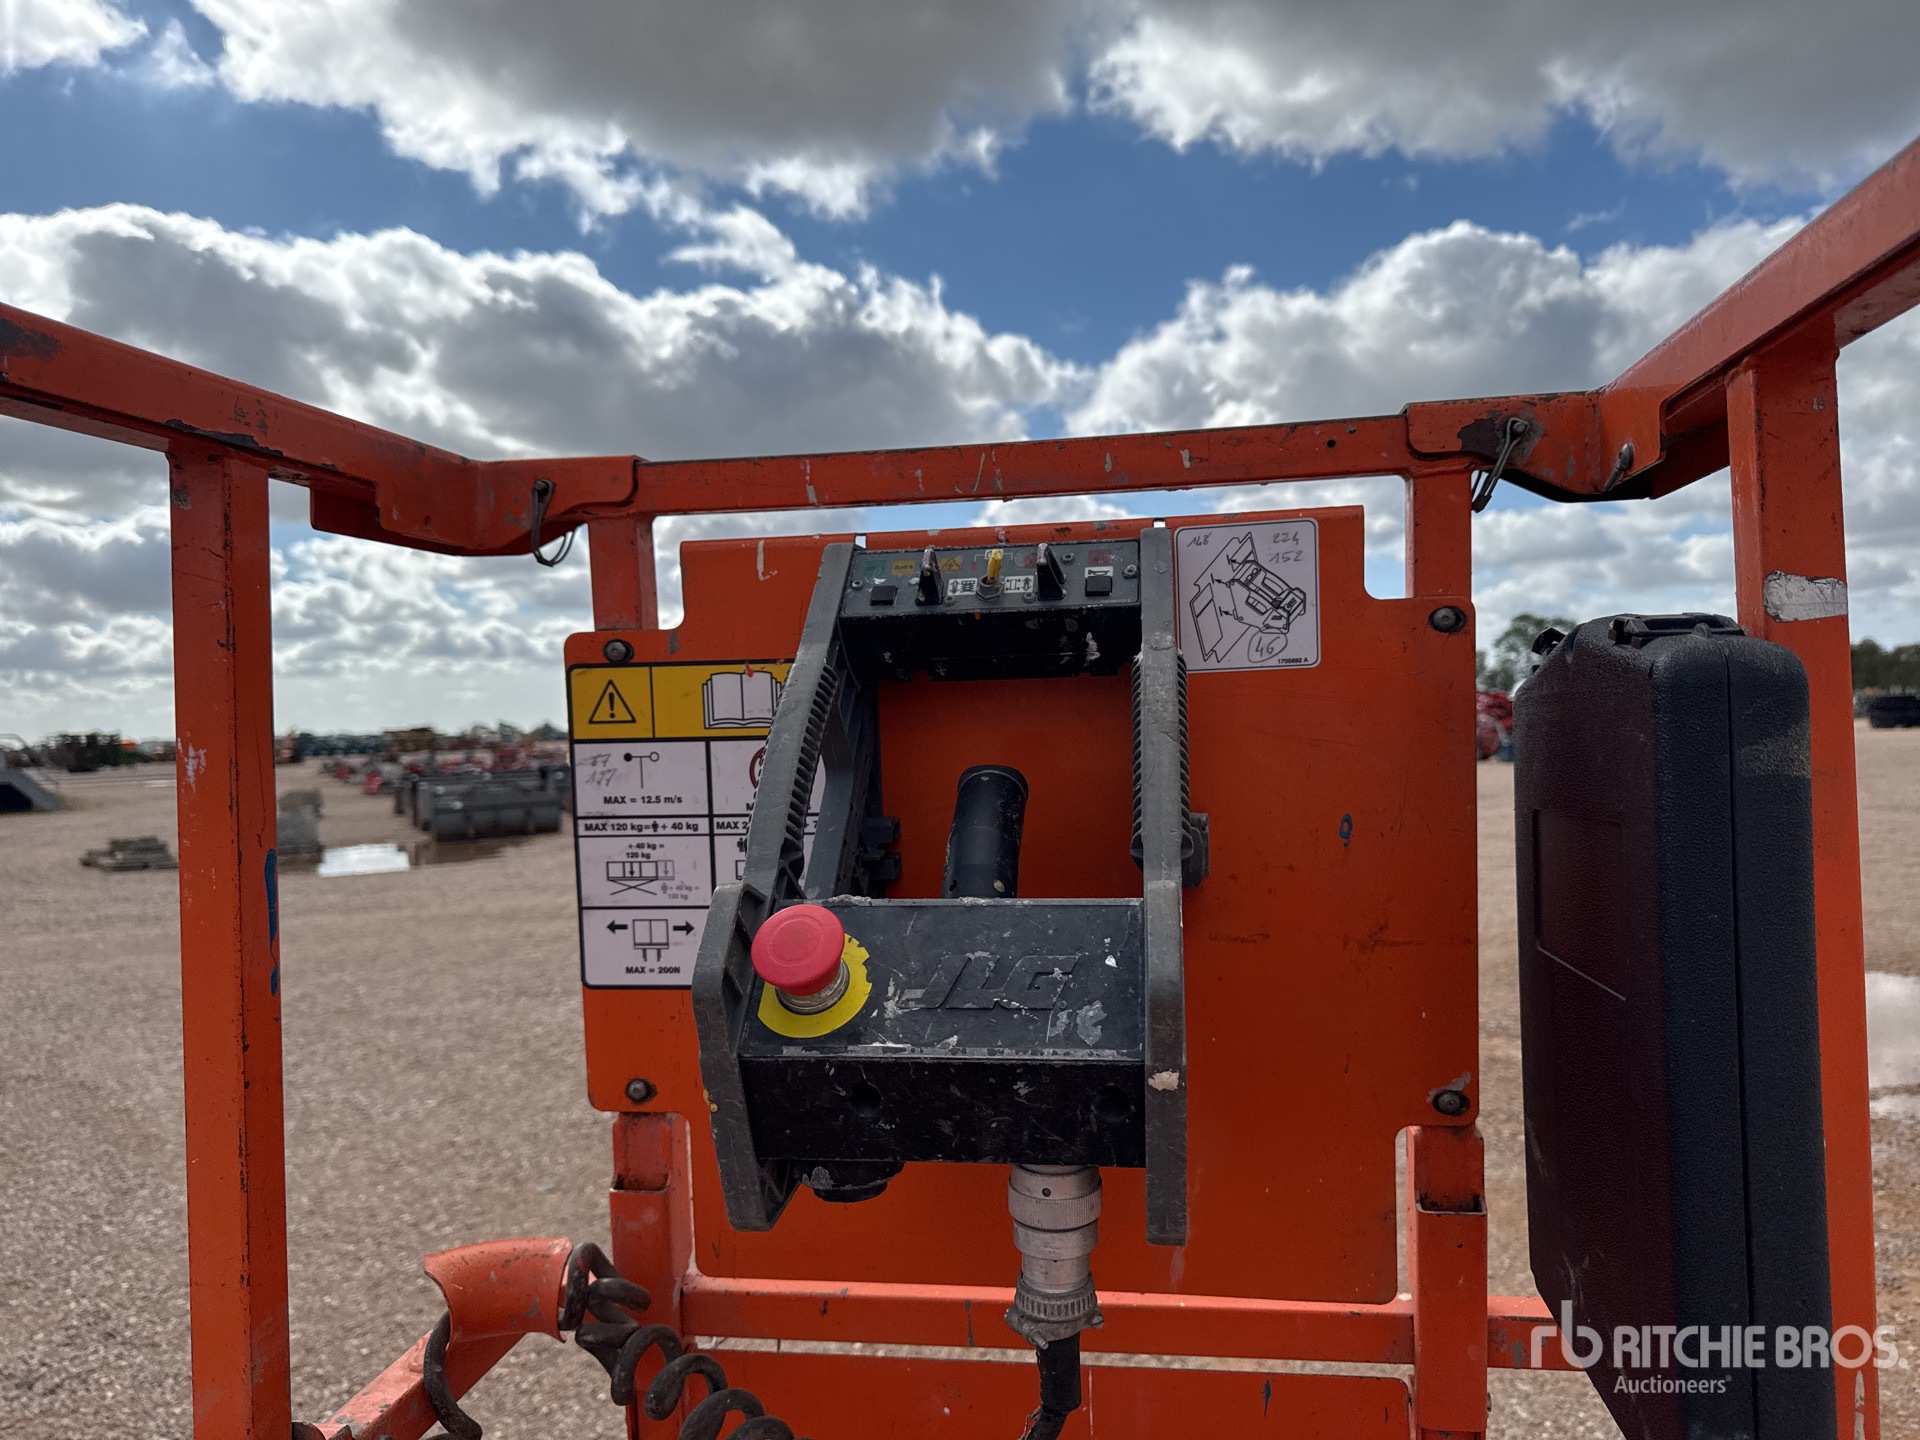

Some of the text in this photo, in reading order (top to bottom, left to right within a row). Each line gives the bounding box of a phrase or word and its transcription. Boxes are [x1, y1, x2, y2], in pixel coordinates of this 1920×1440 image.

[1273, 531, 1299, 546] 224
[1269, 550, 1303, 564] 152
[1255, 636, 1281, 657] 46
[603, 795, 627, 804] MAX
[640, 795, 661, 804] 12.5
[663, 795, 683, 805] m/s
[584, 823, 608, 832] MAX
[610, 822, 628, 831] 120
[671, 822, 683, 830] 40
[686, 821, 699, 832] kg
[716, 821, 740, 830] MAX
[646, 842, 657, 850] kg
[641, 852, 651, 860] kg
[680, 893, 689, 901] kg
[625, 965, 647, 974] MAX
[657, 966, 681, 974] 200N
[895, 954, 1081, 1011] JLG
